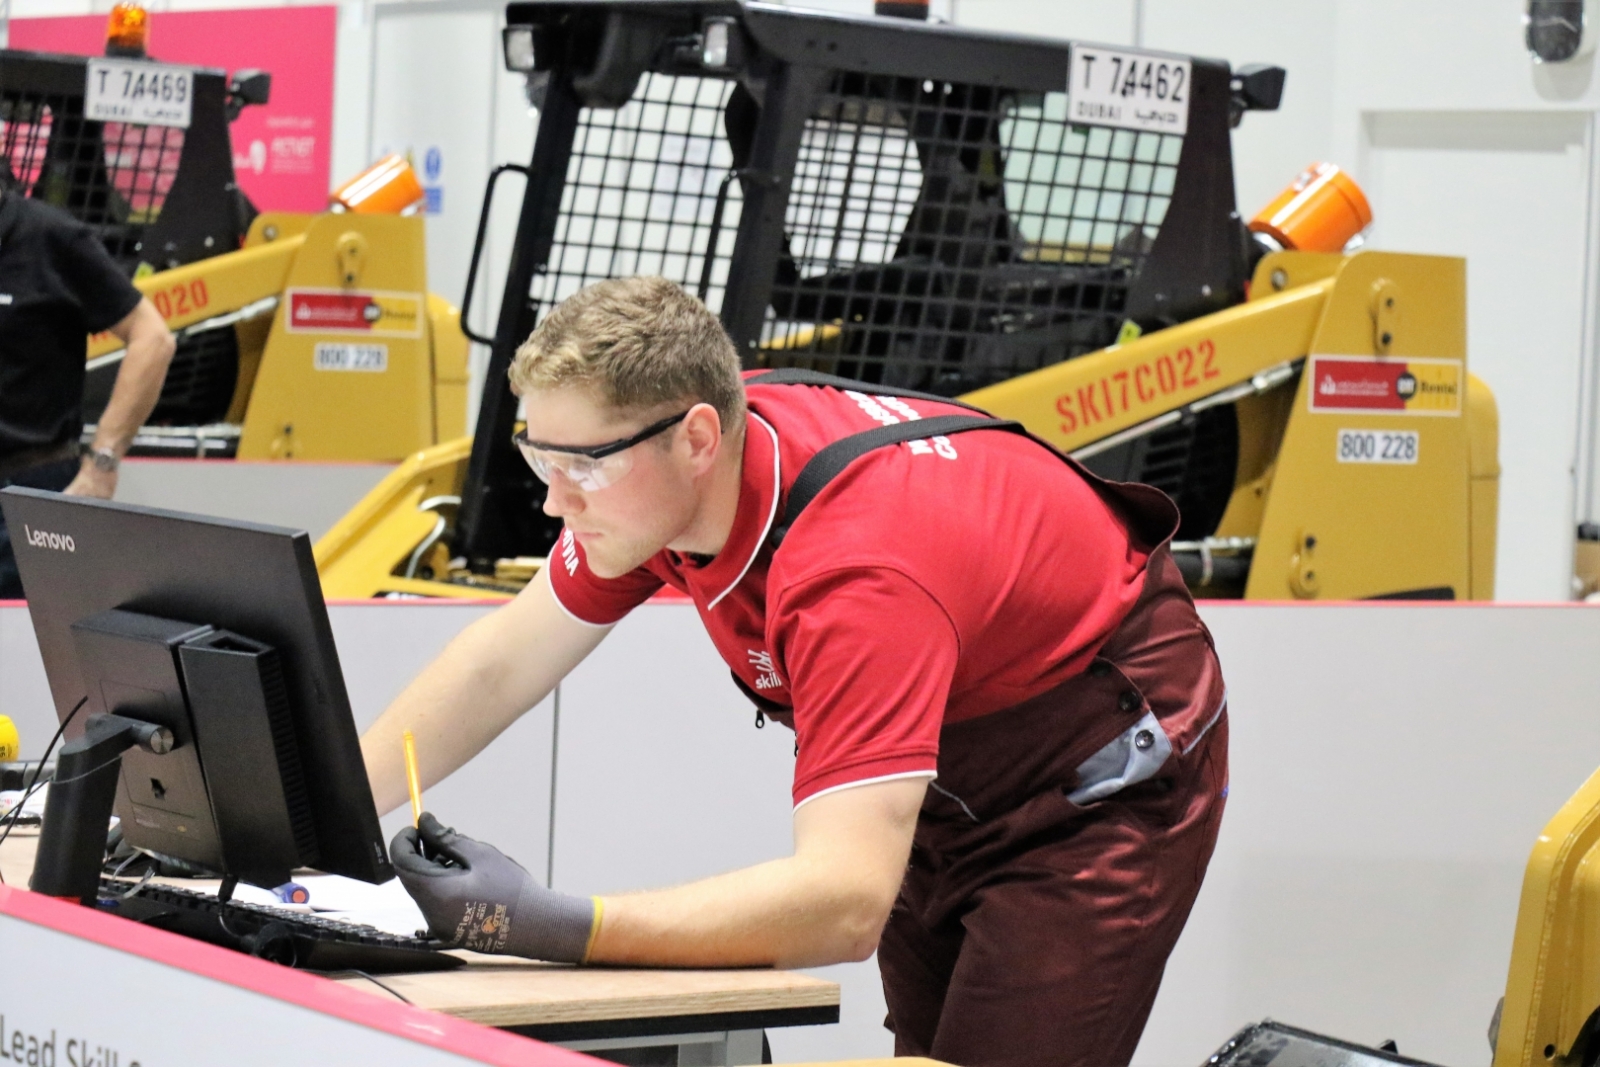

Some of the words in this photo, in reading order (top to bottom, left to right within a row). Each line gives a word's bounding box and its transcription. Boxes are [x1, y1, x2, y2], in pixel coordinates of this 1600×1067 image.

[97, 69, 110, 94] T
[1081, 54, 1097, 90] T
[1111, 56, 1186, 102] 74462
[1340, 433, 1375, 459] 800
[1381, 435, 1417, 460] 228
[24, 523, 76, 553] Lenovo
[0, 1013, 56, 1067] Lead
